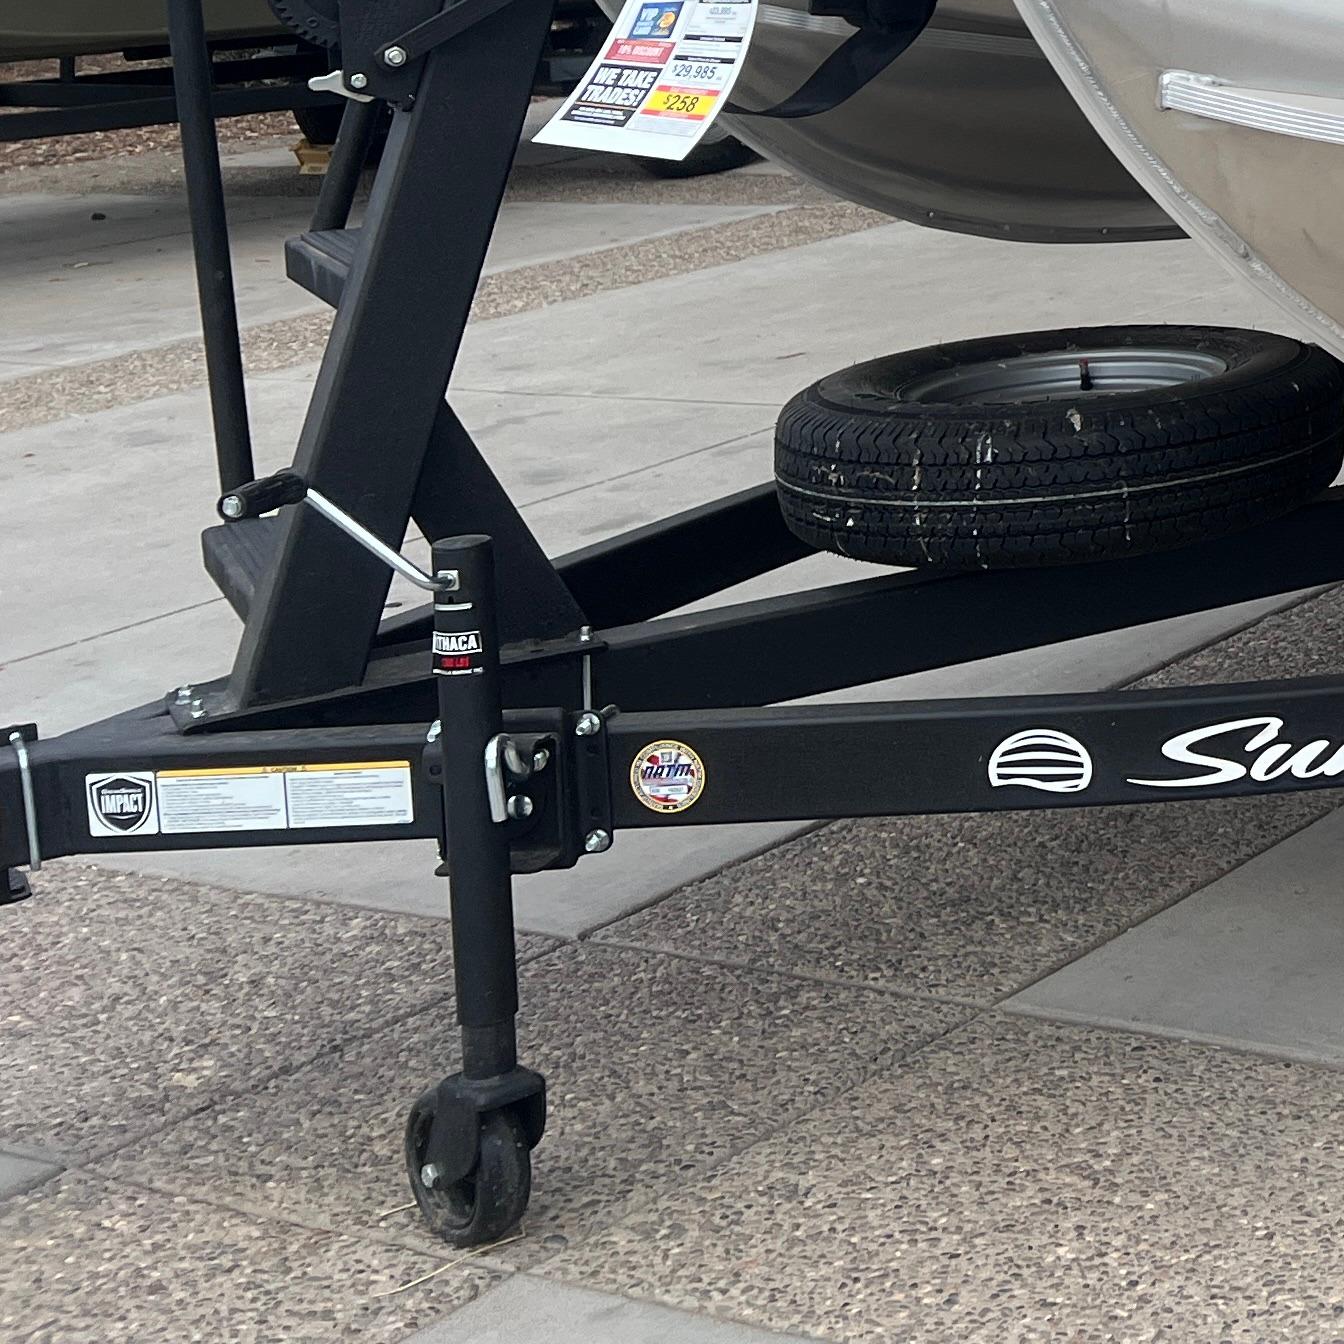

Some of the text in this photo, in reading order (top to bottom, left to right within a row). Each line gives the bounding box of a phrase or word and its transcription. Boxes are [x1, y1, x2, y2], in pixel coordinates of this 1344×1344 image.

[593, 67, 658, 89] WE TAKE
[580, 84, 647, 107] TRADES!
[663, 94, 699, 113] $258
[100, 793, 143, 814] IMPACT
